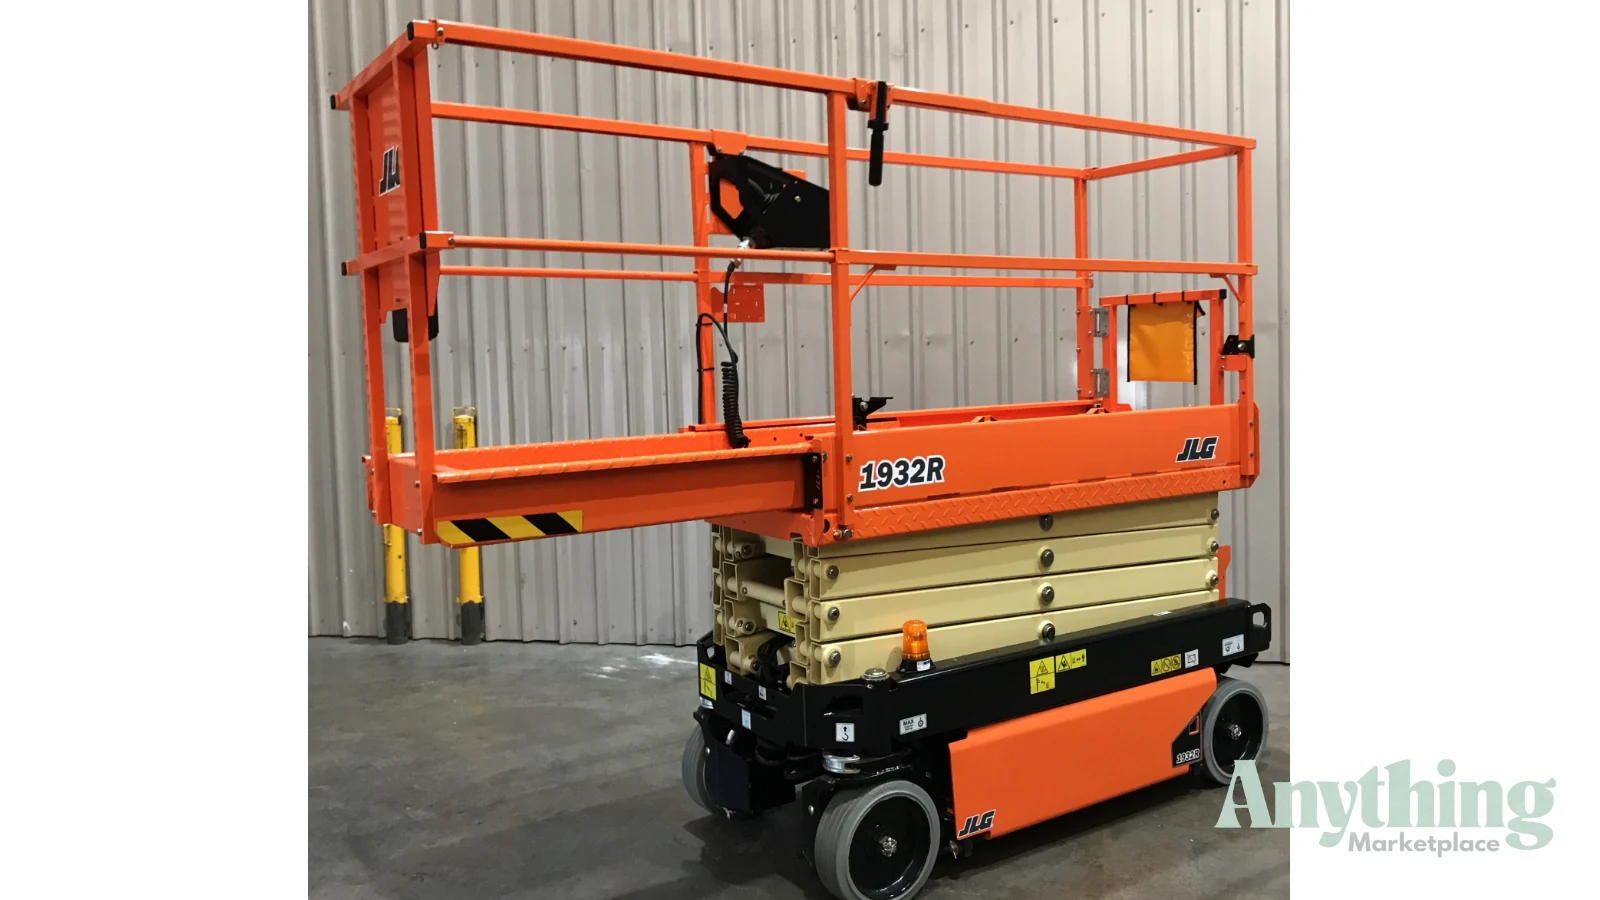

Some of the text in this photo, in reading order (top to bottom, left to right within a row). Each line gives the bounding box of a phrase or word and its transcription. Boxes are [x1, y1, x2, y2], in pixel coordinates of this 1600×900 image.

[1176, 437, 1218, 462] JLG
[859, 456, 945, 491] 1932R
[1176, 749, 1200, 764] 1932R
[957, 810, 995, 839] JLG
